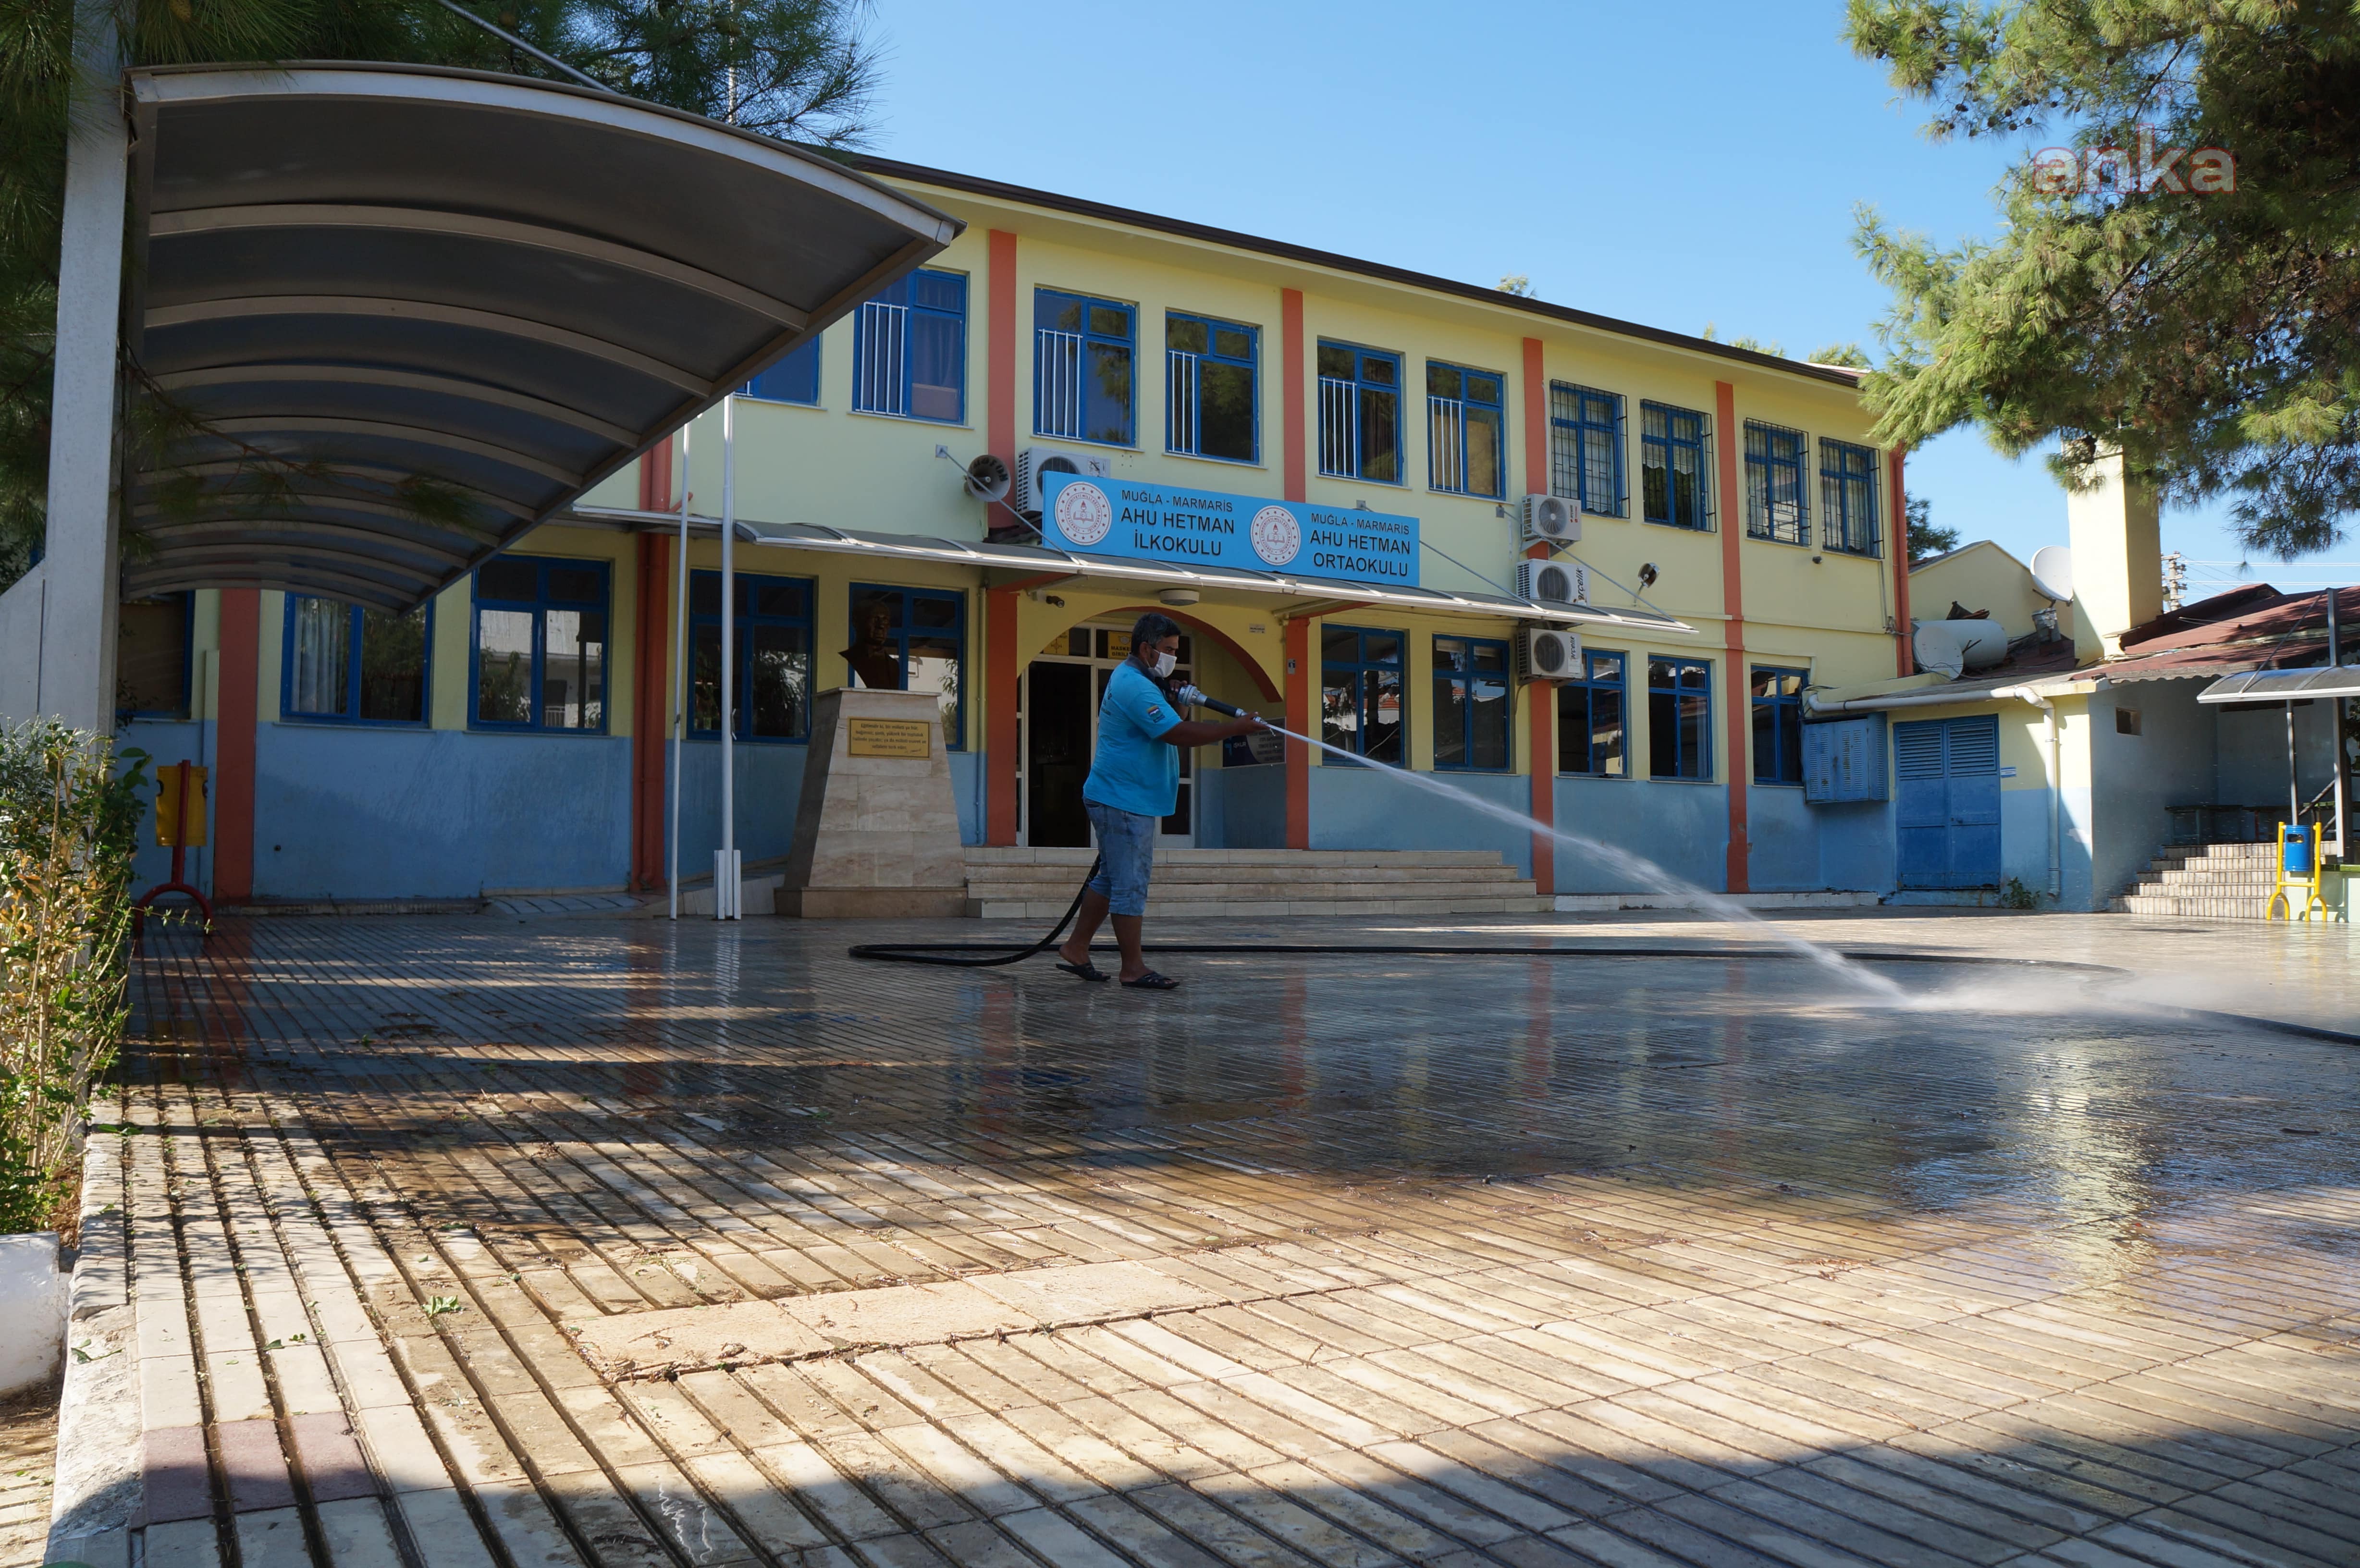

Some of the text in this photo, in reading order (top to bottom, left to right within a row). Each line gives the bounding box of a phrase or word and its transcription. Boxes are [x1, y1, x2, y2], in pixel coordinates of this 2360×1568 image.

[1122, 490, 1163, 504] MUĞLA
[1173, 496, 1233, 512] MARMARİS
[1120, 507, 1234, 534] AHU HETMAN
[1311, 513, 1348, 527] MUĞLA
[1357, 519, 1409, 535] MARMARİS
[1134, 529, 1221, 556] İLKOKULU
[1310, 529, 1410, 554] AHU HETMAN
[1314, 552, 1408, 576] ORTAOKULU
[1576, 567, 1585, 600] arçelik
